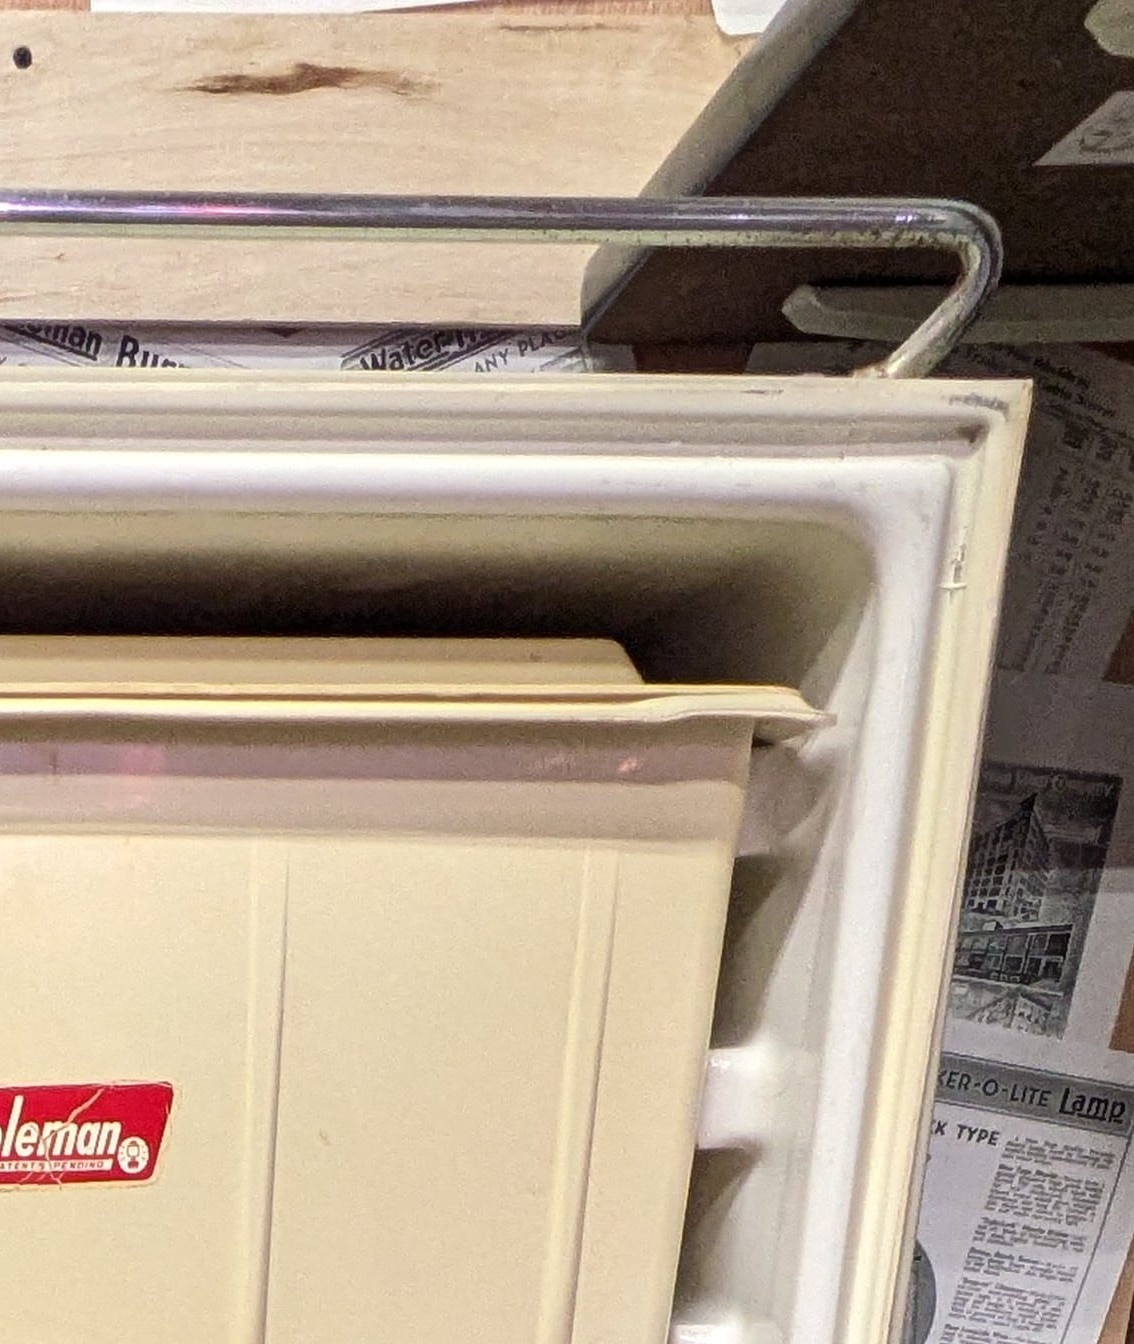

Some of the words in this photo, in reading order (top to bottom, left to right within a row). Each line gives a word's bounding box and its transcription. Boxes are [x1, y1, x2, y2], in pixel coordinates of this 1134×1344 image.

[517, 330, 566, 357] PLAC
[1059, 1088, 1126, 1124] Lamp
[957, 1124, 1001, 1146] TYPE
